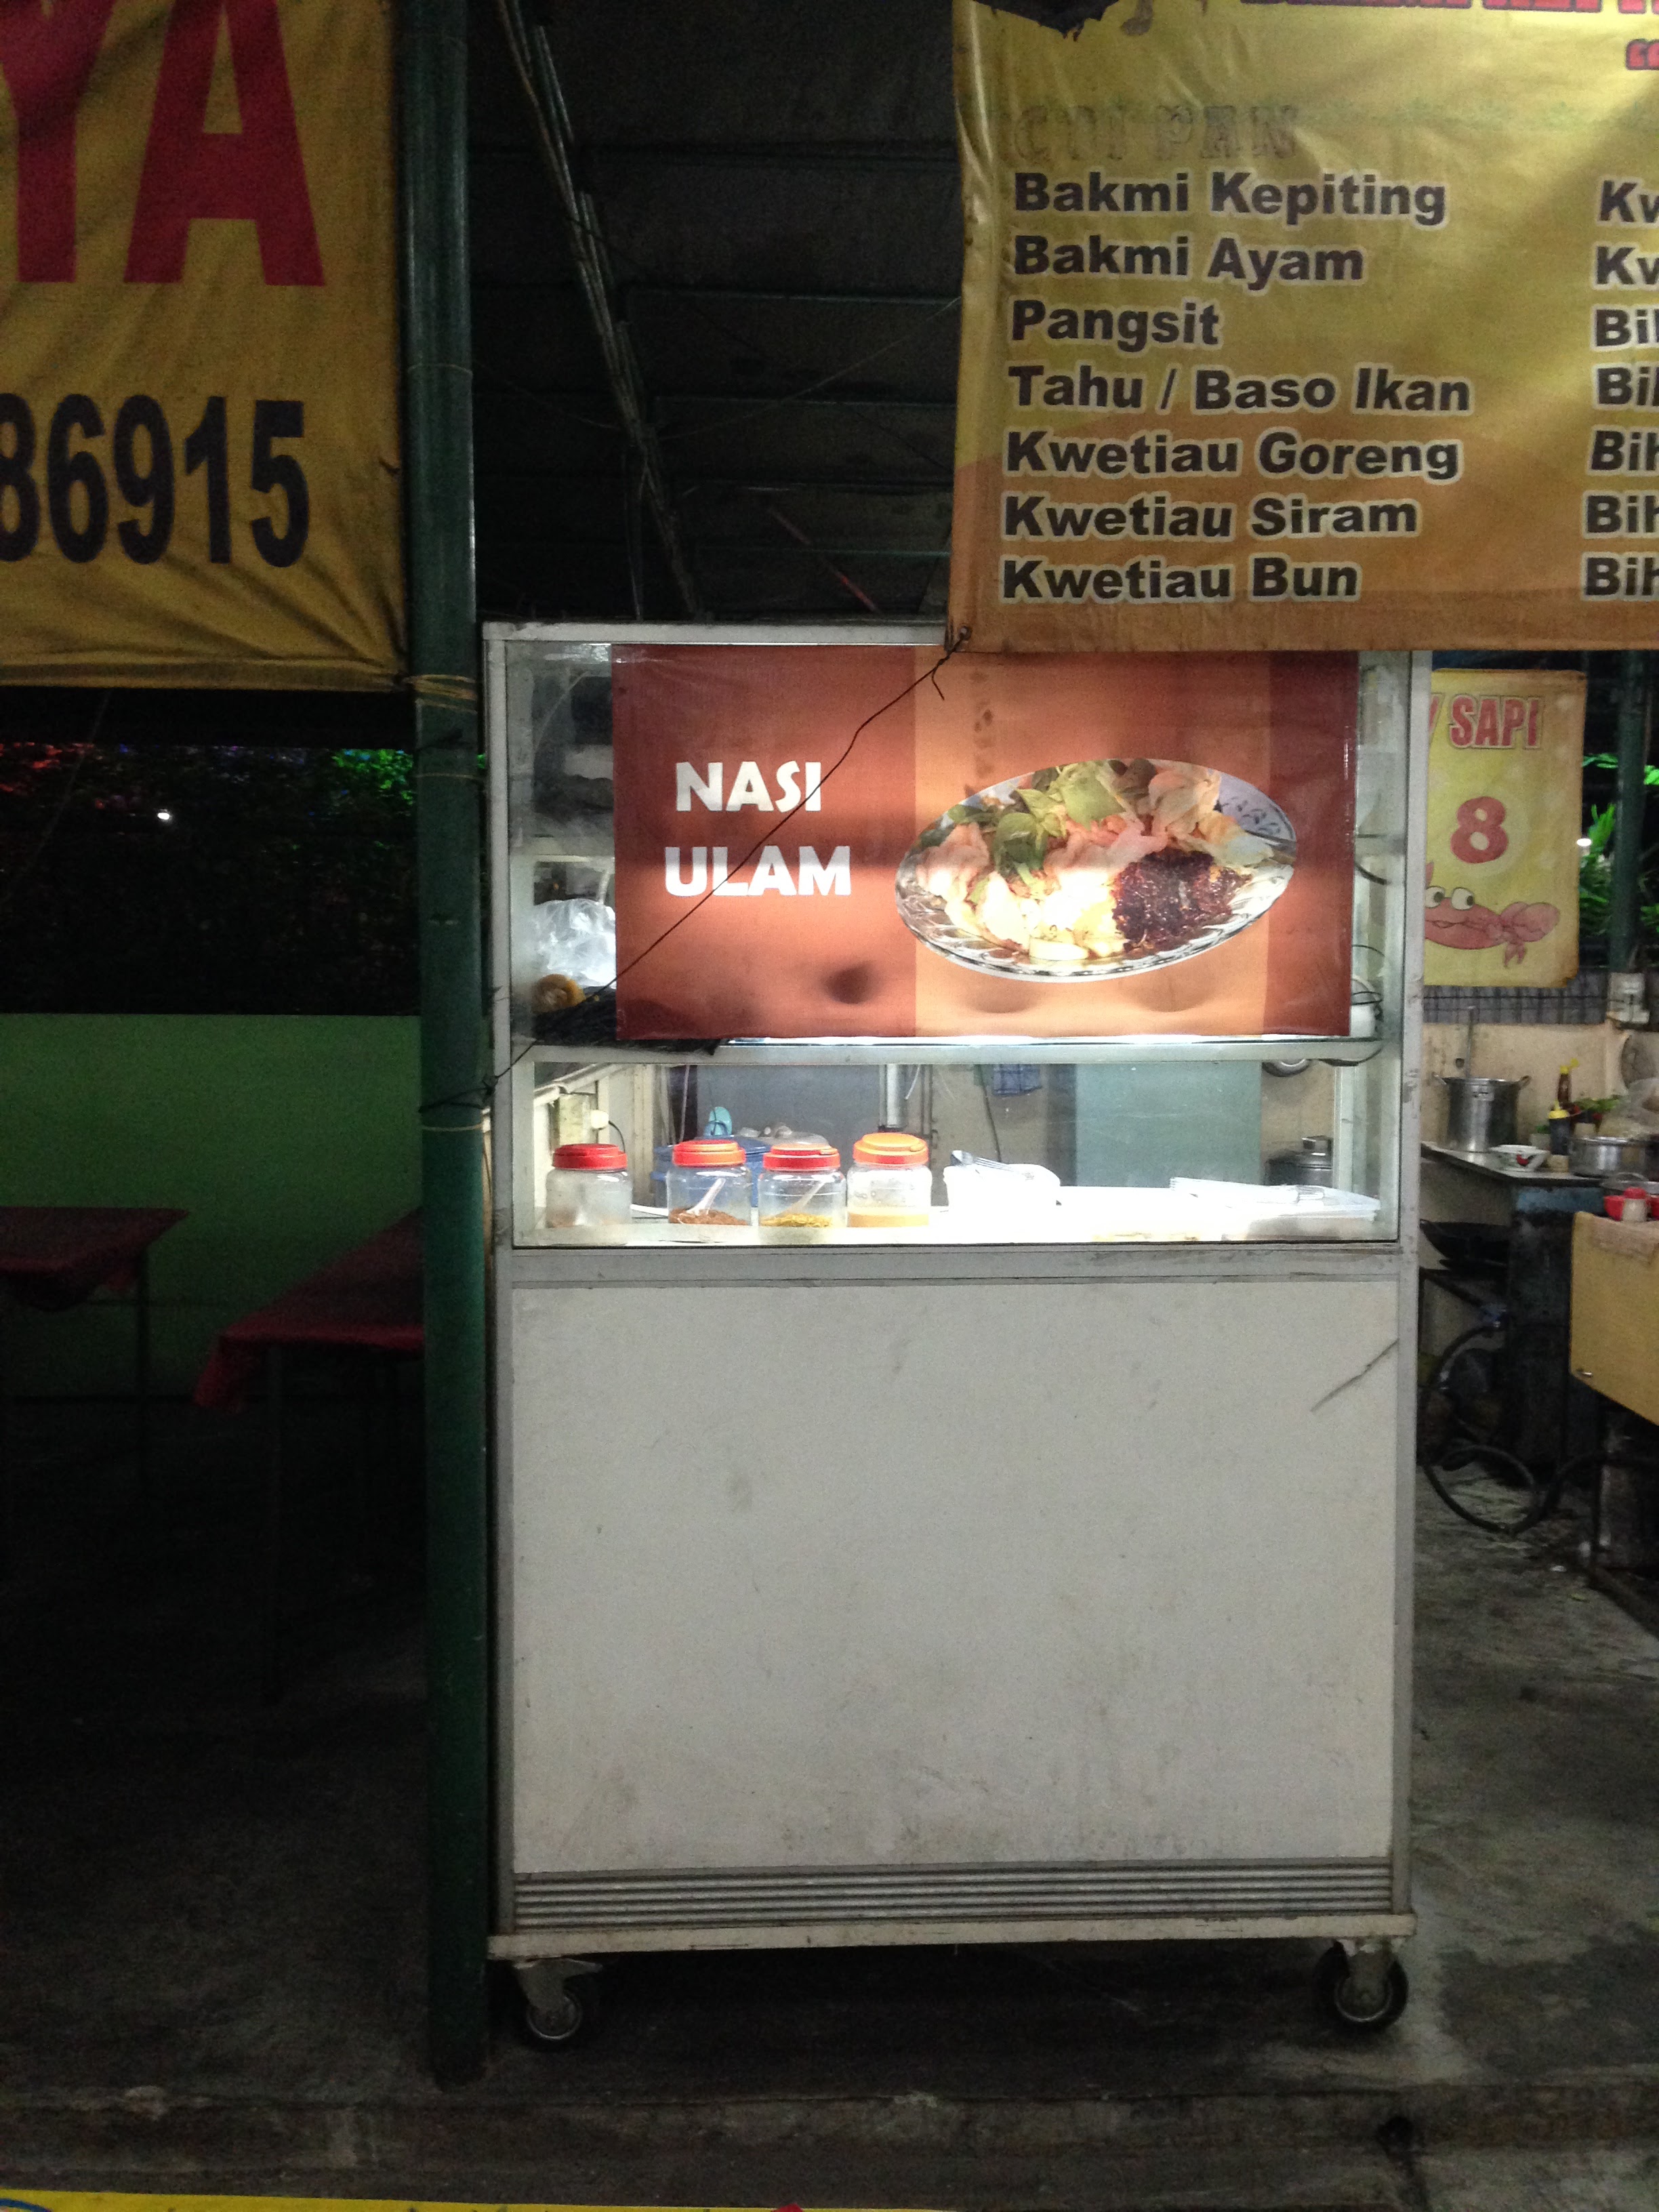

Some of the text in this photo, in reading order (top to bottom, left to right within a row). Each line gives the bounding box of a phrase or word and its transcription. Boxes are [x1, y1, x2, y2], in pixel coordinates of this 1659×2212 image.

[1014, 171, 1446, 226] Bakmi Kepiting
[1014, 234, 1364, 291] Bakmi Ayam
[1012, 300, 1218, 353] Pangsit
[1597, 309, 1659, 346] Bi
[1008, 365, 1470, 411] Tahu / Baso Ikan
[1597, 367, 1659, 406] Bi
[0, 393, 309, 567] 86915
[1006, 430, 1458, 480] Kwetiau Goreng
[1003, 495, 1418, 537] Kwetiau Siram
[1002, 557, 1358, 598] Kwetiau Bun
[1449, 695, 1543, 748] SAPI
[676, 761, 821, 812] NASI
[1450, 796, 1509, 864] 8
[664, 845, 851, 897] ULAM
